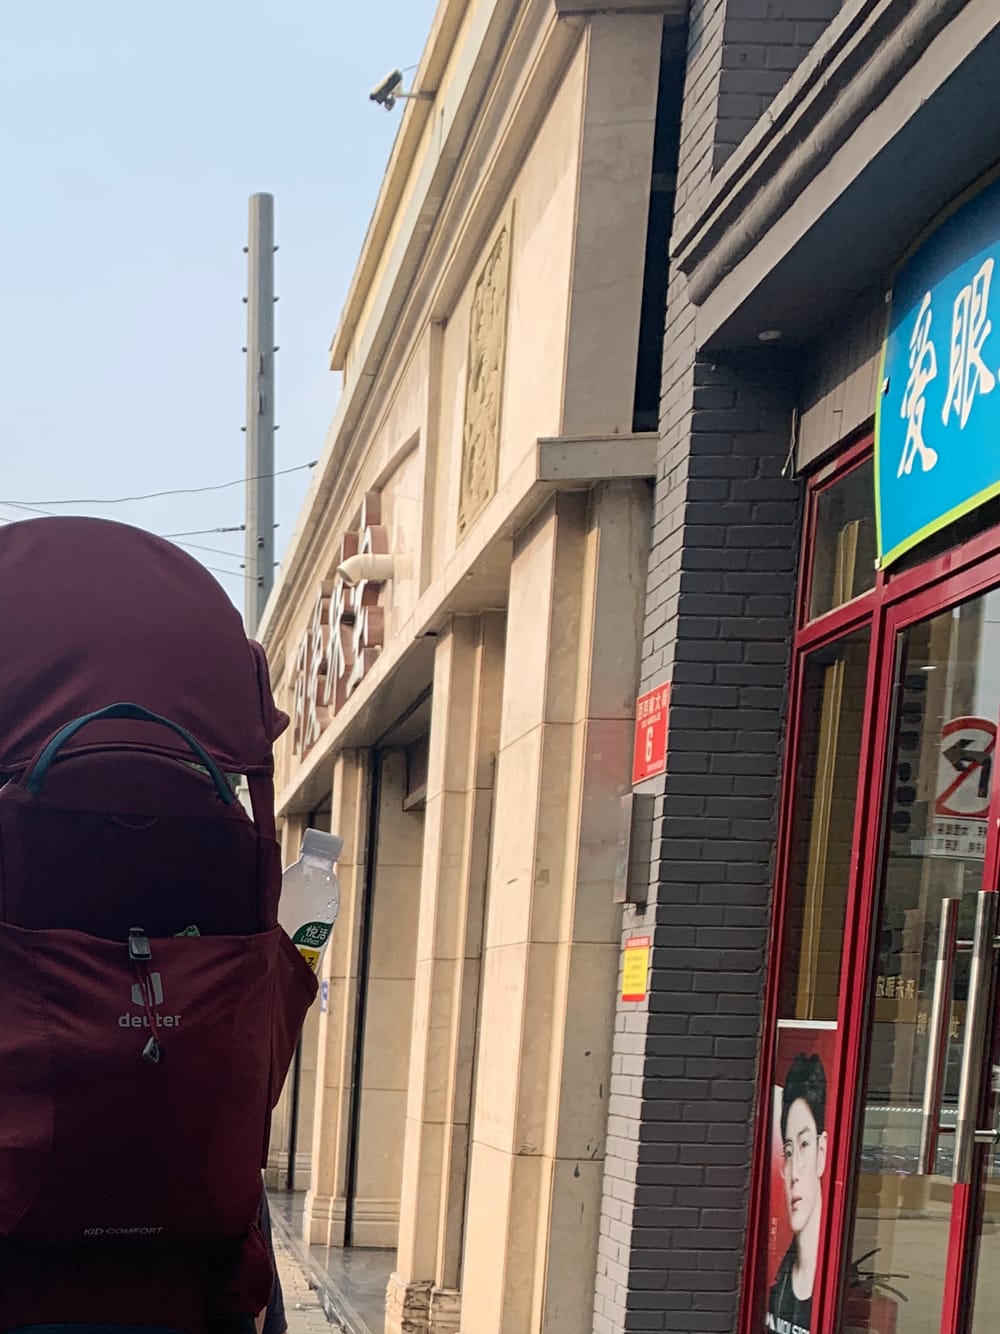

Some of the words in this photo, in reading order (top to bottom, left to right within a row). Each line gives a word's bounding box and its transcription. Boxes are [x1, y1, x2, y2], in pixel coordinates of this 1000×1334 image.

[645, 726, 653, 763] 6
[306, 925, 328, 940] 悦活
[106, 1227, 163, 1235] COMFORT
